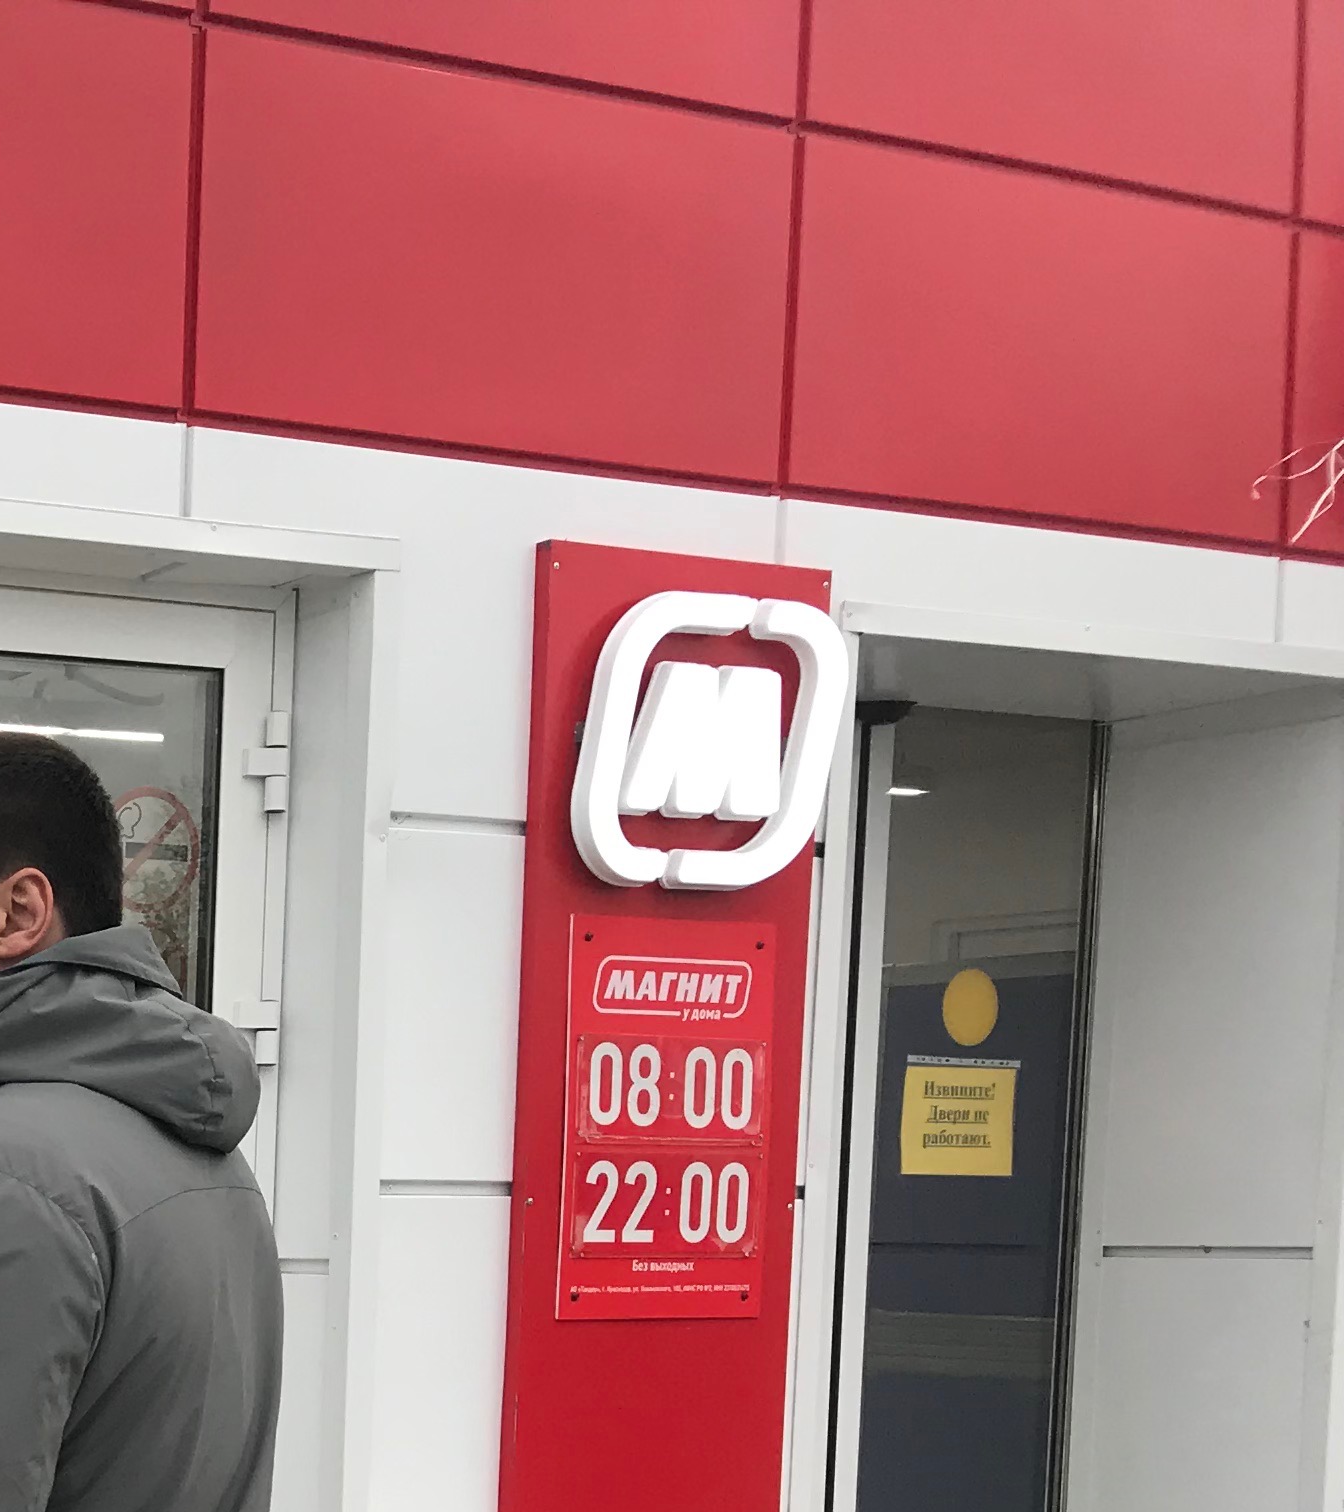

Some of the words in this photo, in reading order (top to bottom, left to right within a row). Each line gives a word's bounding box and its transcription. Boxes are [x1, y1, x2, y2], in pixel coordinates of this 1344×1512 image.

[603, 969, 743, 1005] МАГНИТ
[691, 1008, 721, 1021] дома
[927, 1105, 970, 1124] Двери
[922, 1130, 991, 1148] работают.
[632, 1259, 648, 1273] Без
